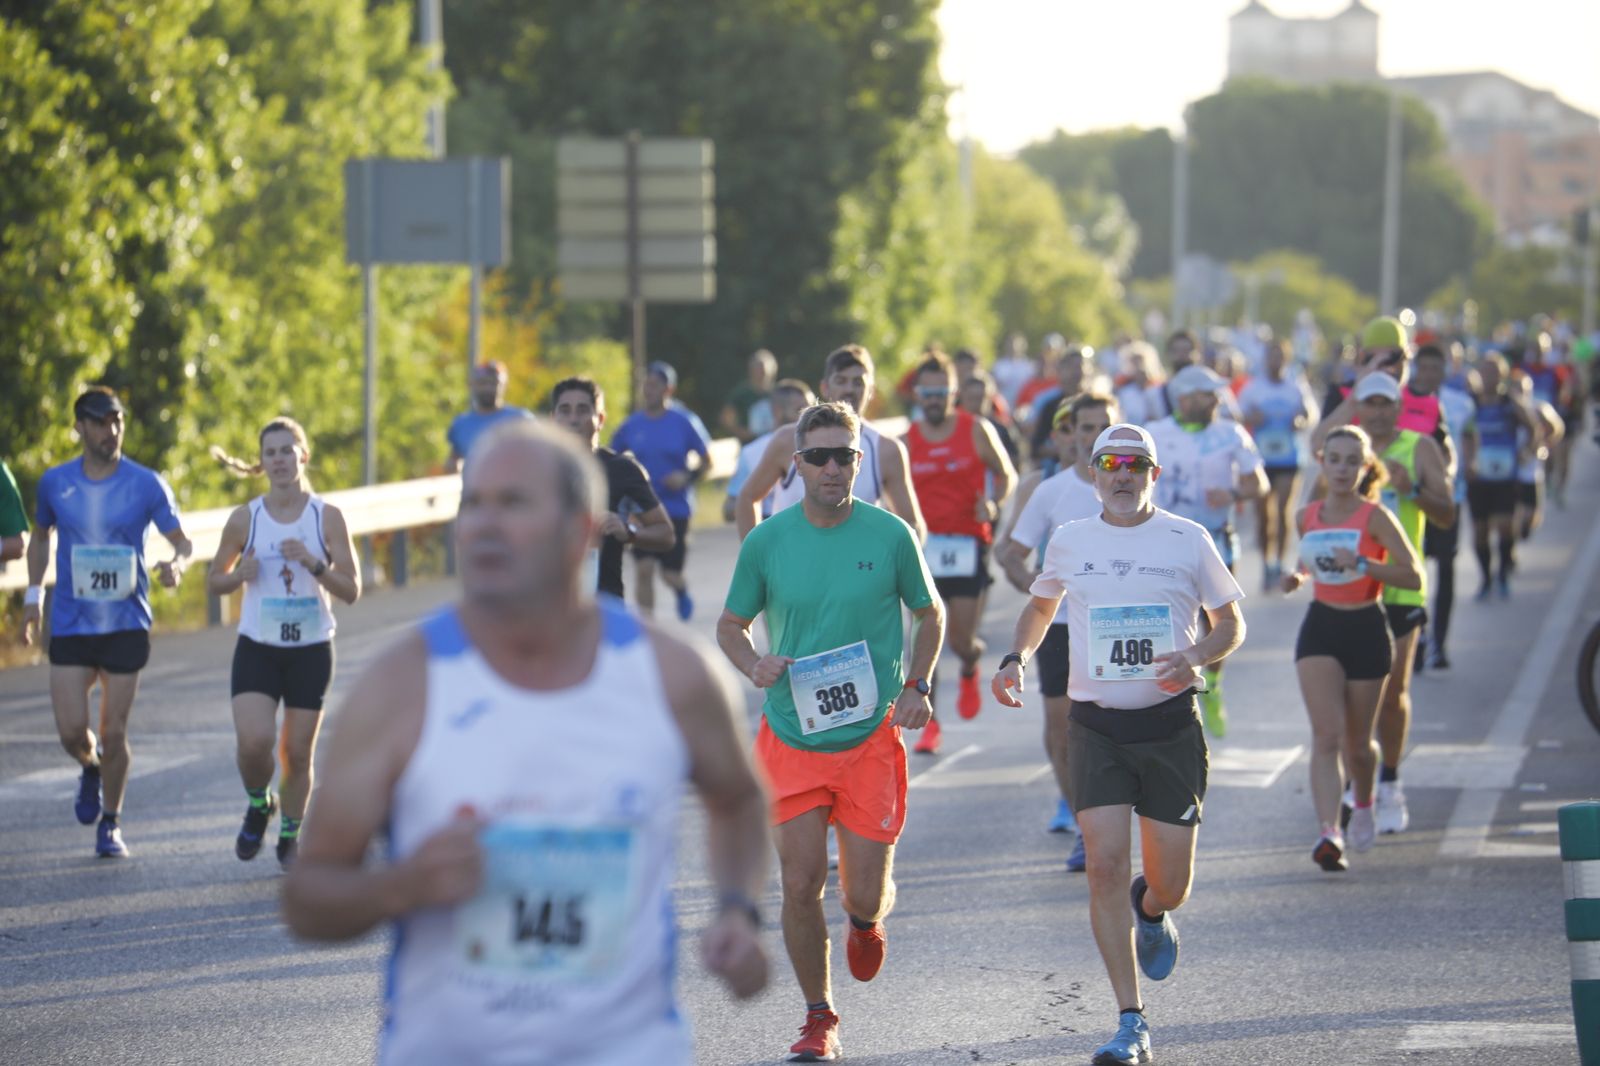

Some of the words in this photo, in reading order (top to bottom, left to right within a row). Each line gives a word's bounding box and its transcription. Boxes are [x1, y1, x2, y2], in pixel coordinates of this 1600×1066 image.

[281, 623, 301, 642] 85
[1091, 618, 1121, 629] MEDIA
[1110, 639, 1153, 666] 496
[793, 669, 821, 681] MEDIA
[816, 682, 859, 716] 388
[513, 893, 585, 946] 145
